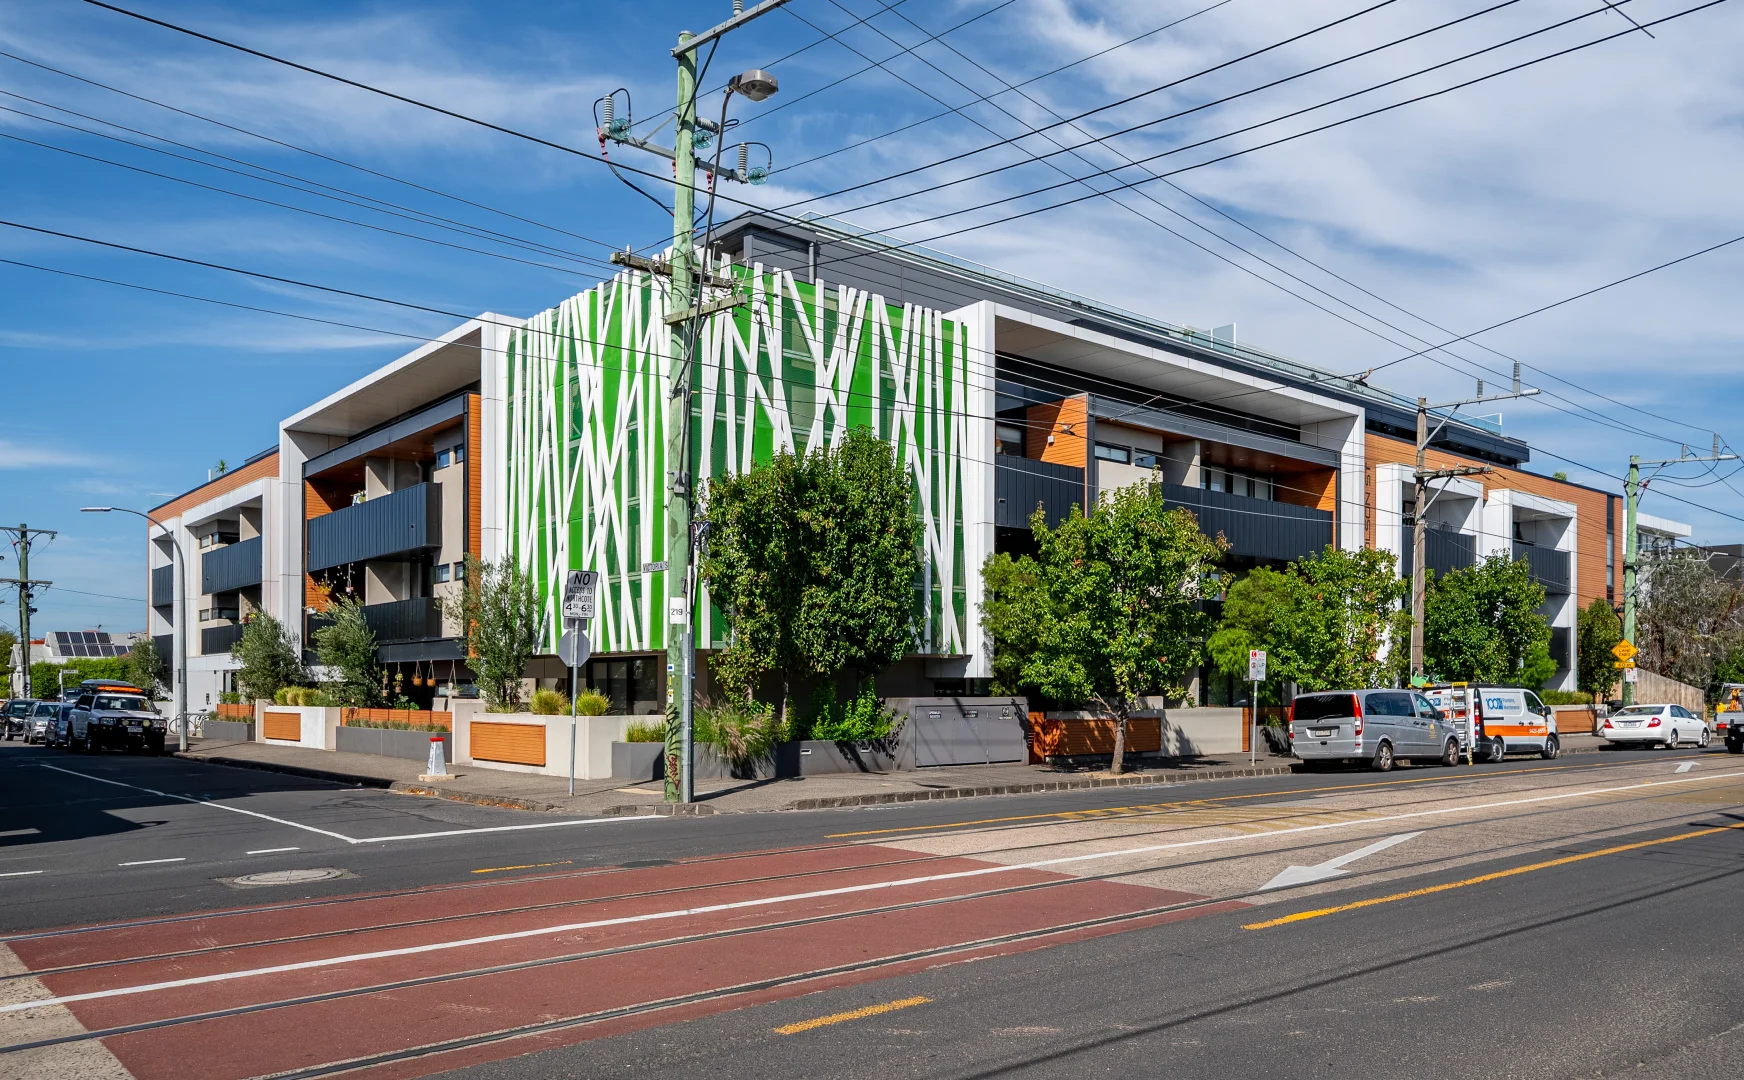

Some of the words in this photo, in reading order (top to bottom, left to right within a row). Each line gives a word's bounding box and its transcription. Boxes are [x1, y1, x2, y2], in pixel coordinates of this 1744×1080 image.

[573, 572, 591, 585] NO
[568, 586, 585, 594] ACCESS
[586, 587, 593, 595] TO
[565, 594, 593, 604] NORTHCOTE
